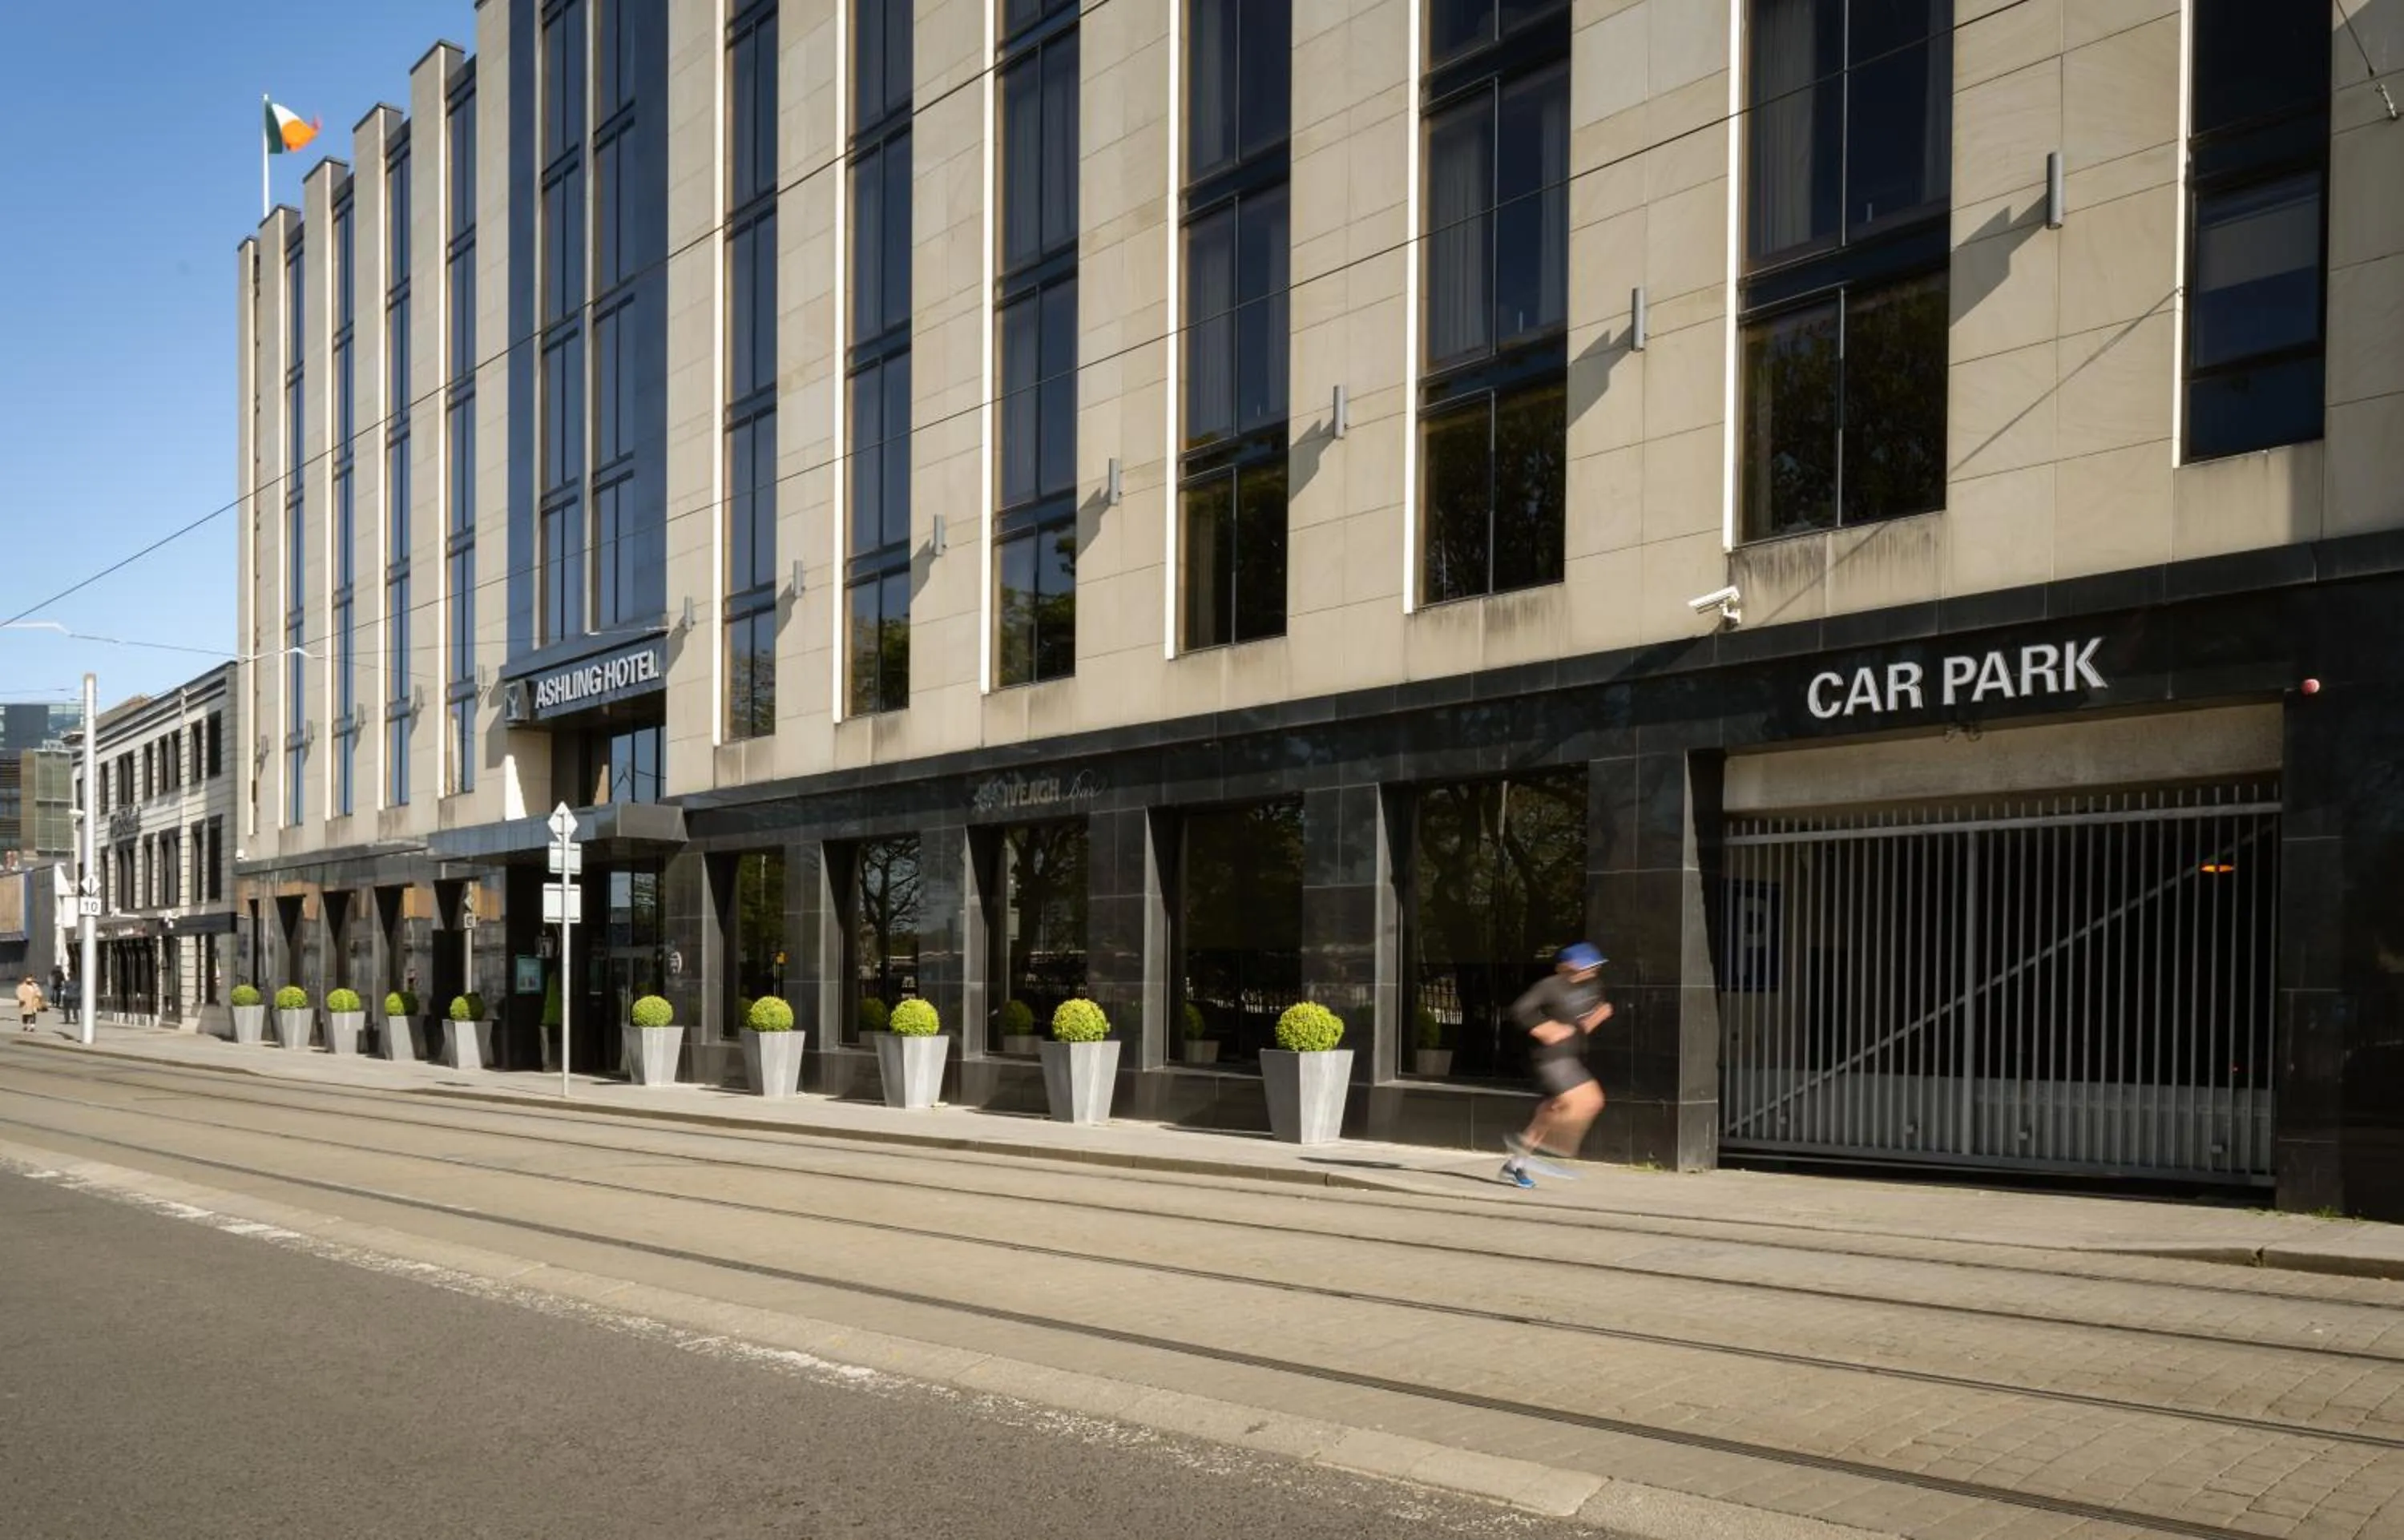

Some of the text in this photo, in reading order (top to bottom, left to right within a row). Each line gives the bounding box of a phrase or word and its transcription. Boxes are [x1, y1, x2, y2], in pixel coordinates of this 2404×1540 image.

[535, 650, 659, 708] ASHLING HOTEL
[1808, 637, 2108, 718] CAR PARK
[1004, 778, 1059, 808] IVEAGH
[84, 901, 97, 912] 10
[1736, 897, 1772, 975] P
